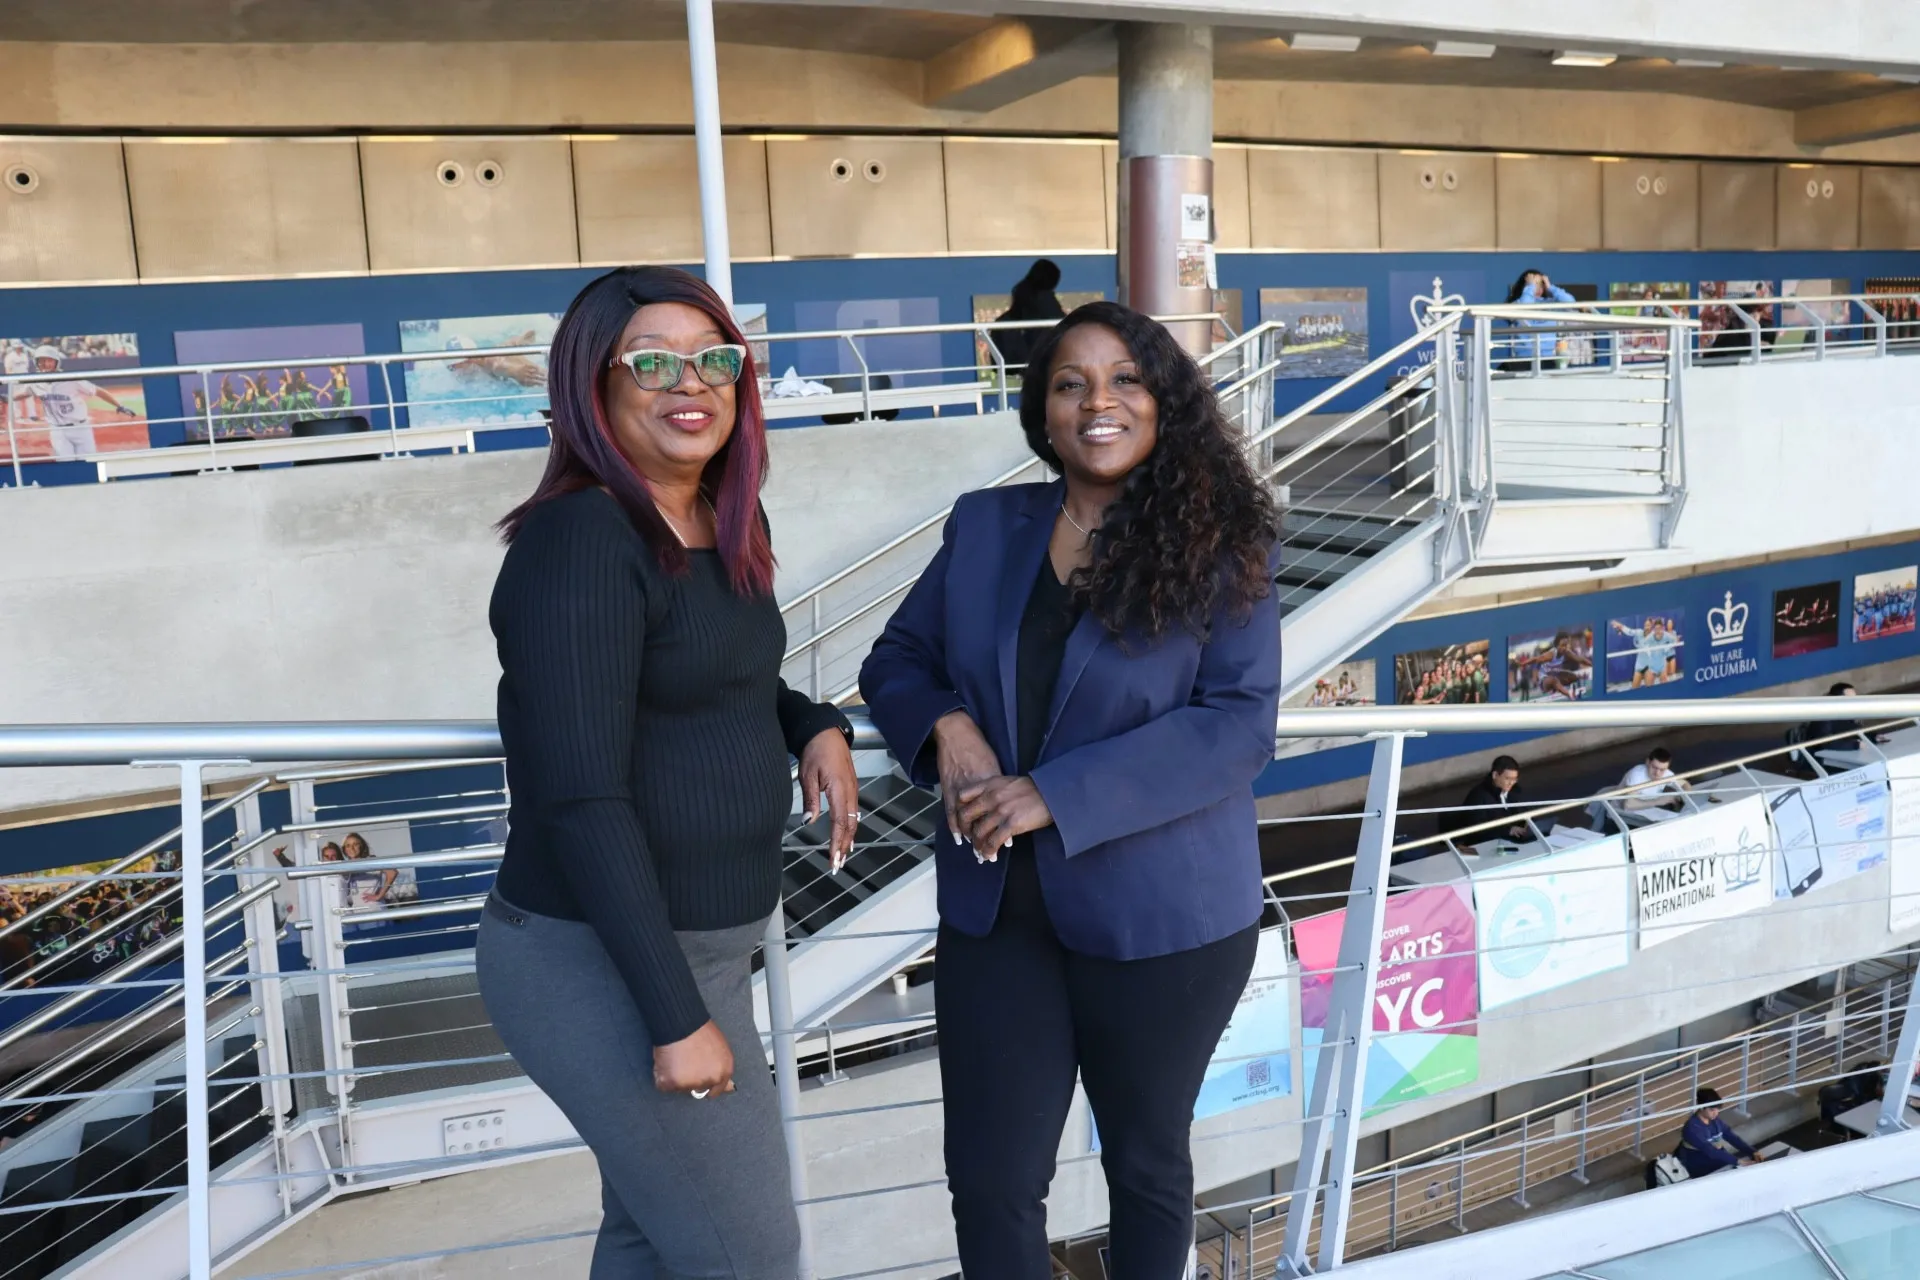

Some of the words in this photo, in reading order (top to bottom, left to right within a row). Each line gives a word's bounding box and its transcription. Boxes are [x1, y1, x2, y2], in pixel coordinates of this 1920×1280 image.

[1695, 658, 1757, 682] COLUMBIA
[1711, 651, 1725, 664] WE
[1726, 648, 1743, 662] ARE
[1641, 851, 1717, 900] AMNESTY
[1641, 884, 1716, 923] INTERNATIONAL
[1383, 925, 1410, 939] COVER
[1387, 931, 1443, 968] ARTS
[1377, 972, 1411, 988] ISCOVER
[1375, 977, 1444, 1033] YC
